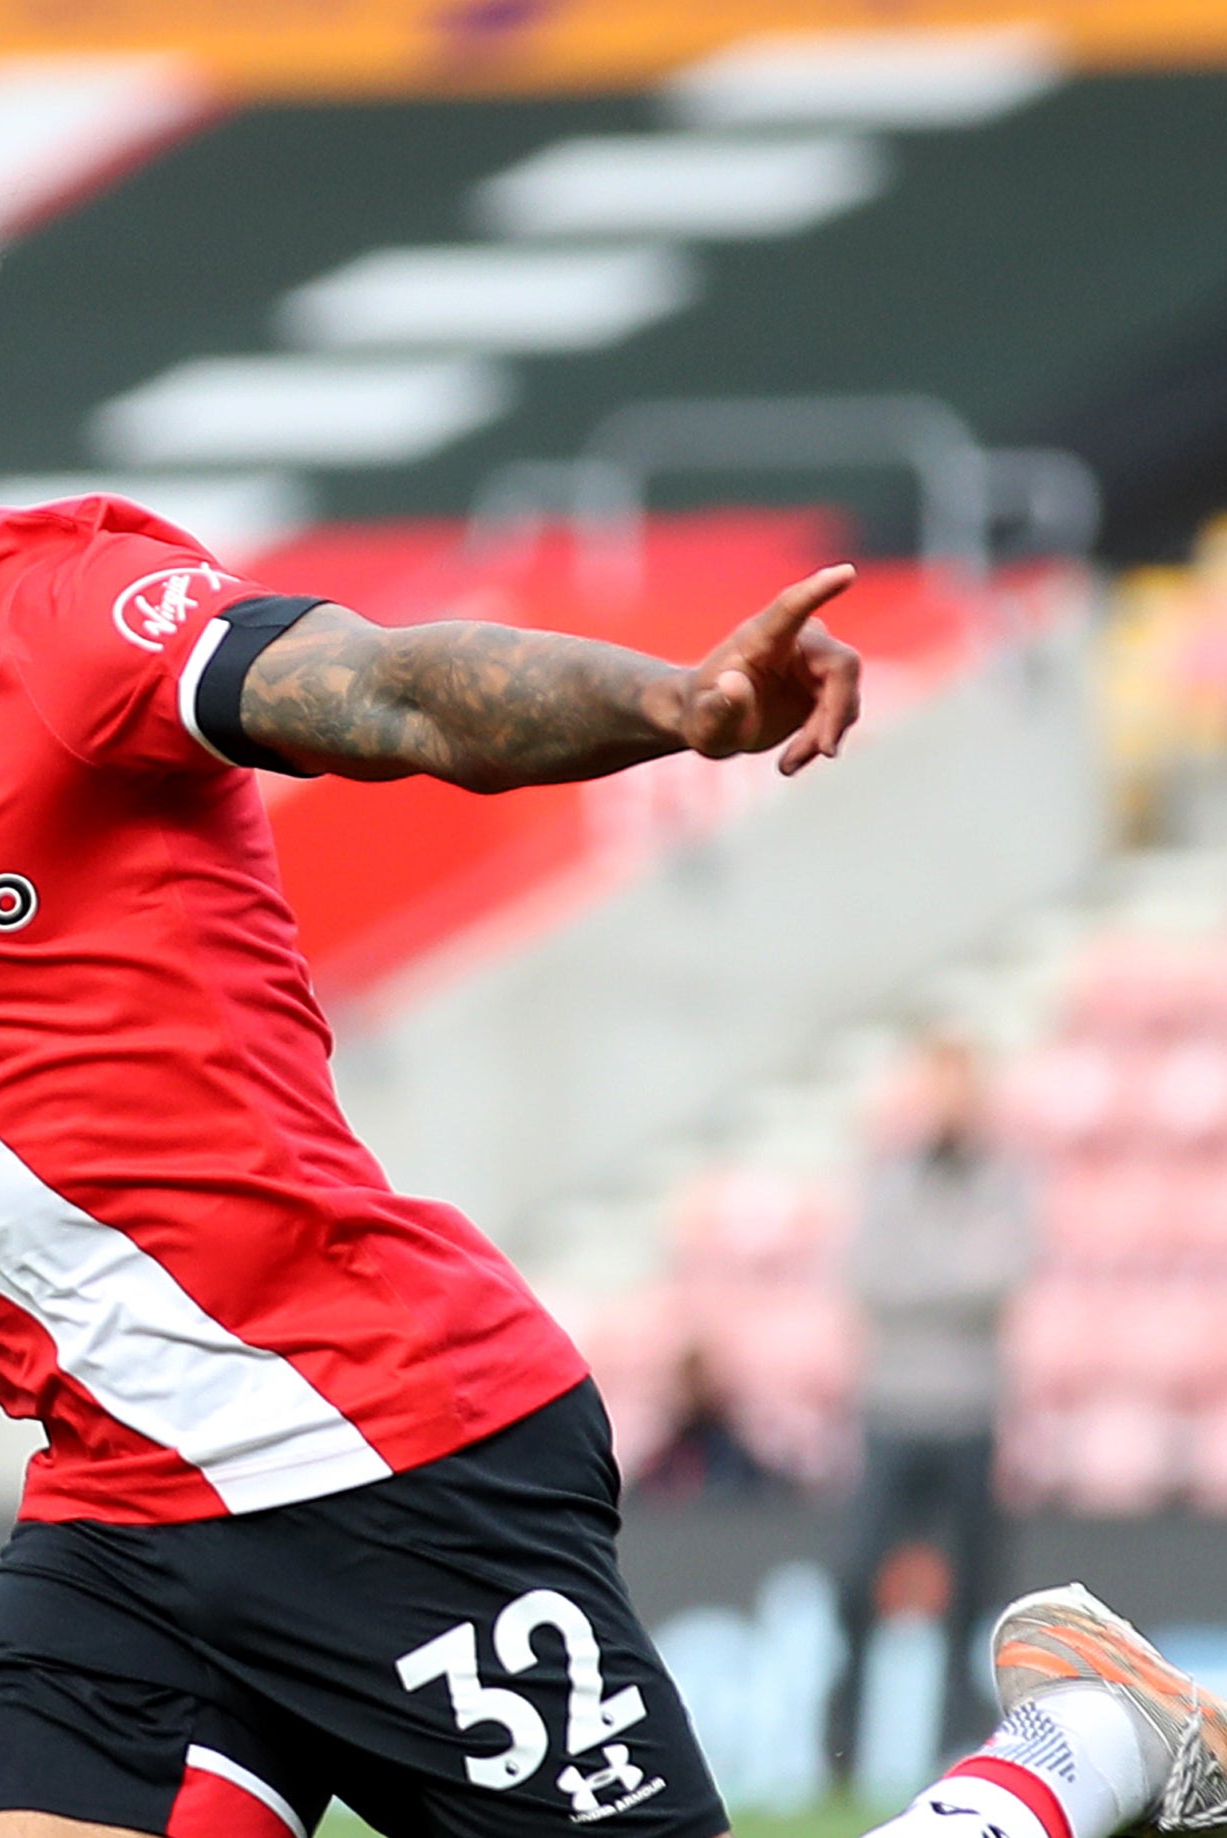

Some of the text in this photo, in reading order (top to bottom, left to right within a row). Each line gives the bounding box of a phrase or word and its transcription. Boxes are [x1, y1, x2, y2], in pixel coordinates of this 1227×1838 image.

[134, 574, 198, 637] Virgin
[395, 1588, 647, 1791] 32
[614, 1776, 667, 1813] ARMOUR
